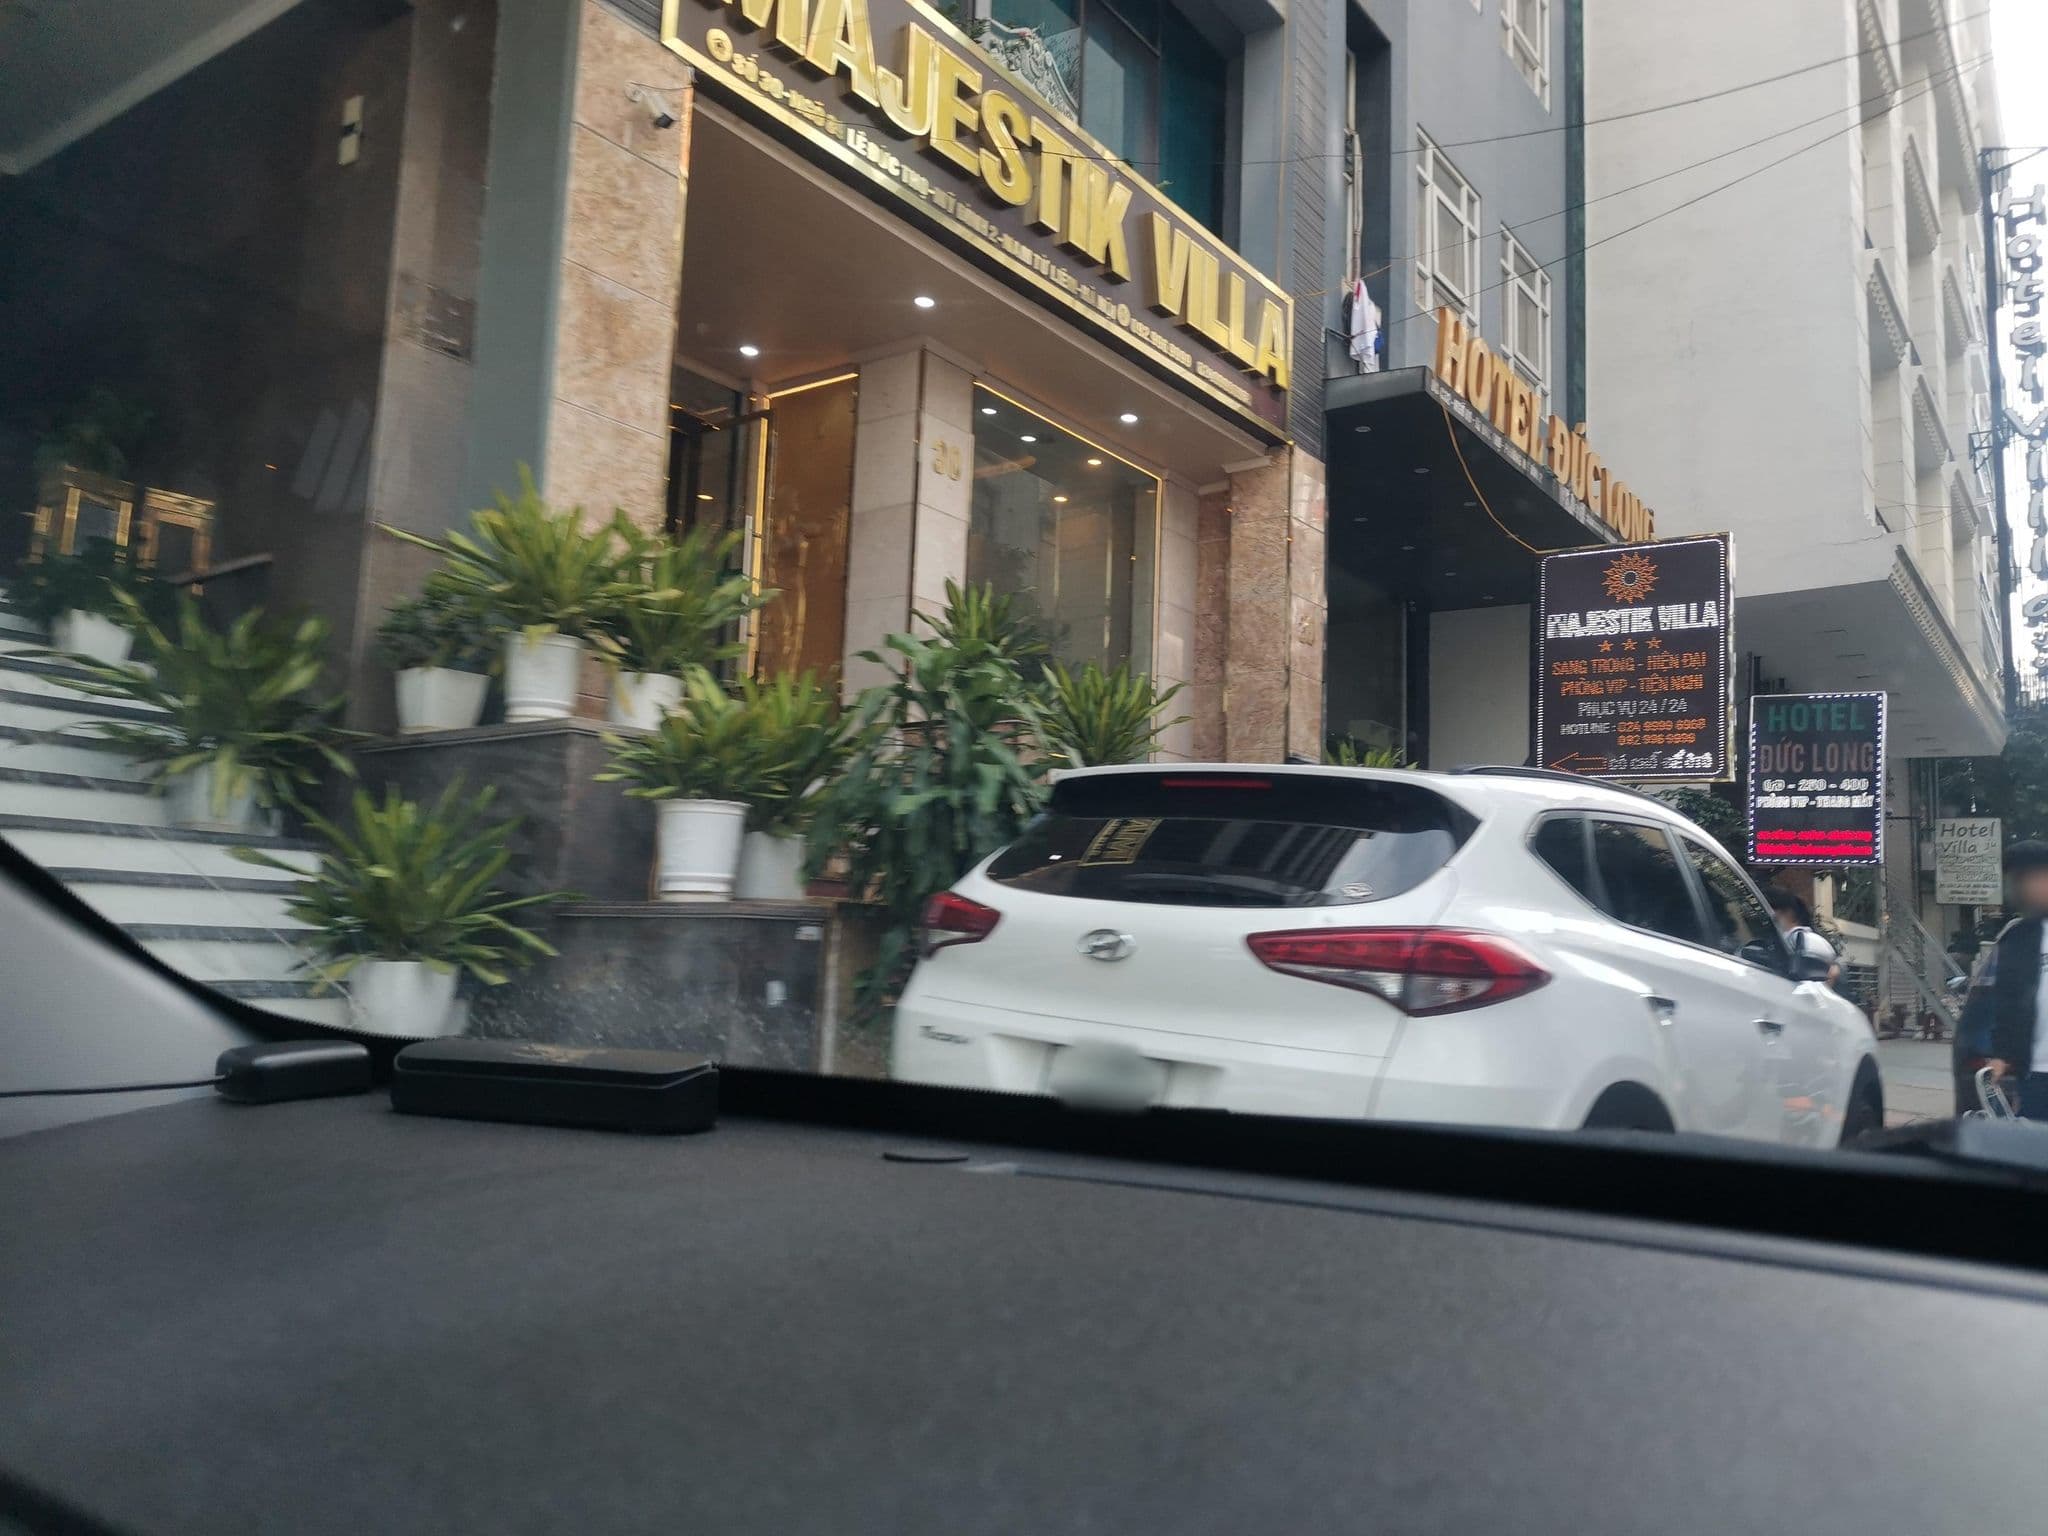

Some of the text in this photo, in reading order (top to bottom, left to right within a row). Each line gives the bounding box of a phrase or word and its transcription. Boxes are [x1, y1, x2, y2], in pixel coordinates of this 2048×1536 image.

[1151, 210, 1289, 390] VILLA
[1998, 184, 2046, 392] Hotel
[1436, 306, 1545, 467] HOTEL
[1548, 415, 1602, 517] ĐỨC
[1547, 600, 1720, 639] MAJESTIK VILLA
[1552, 659, 1589, 676] SANG
[1591, 657, 1636, 676] TRỌNG
[1646, 650, 1680, 673] HIỆN
[1605, 678, 1628, 695] VIP
[1578, 701, 1616, 719] PHỤC
[1768, 702, 1866, 733] HOTEL
[1760, 736, 1874, 773] ĐỨC LONG
[1940, 821, 1996, 838] Hotel
[1941, 840, 1978, 854] Villa
